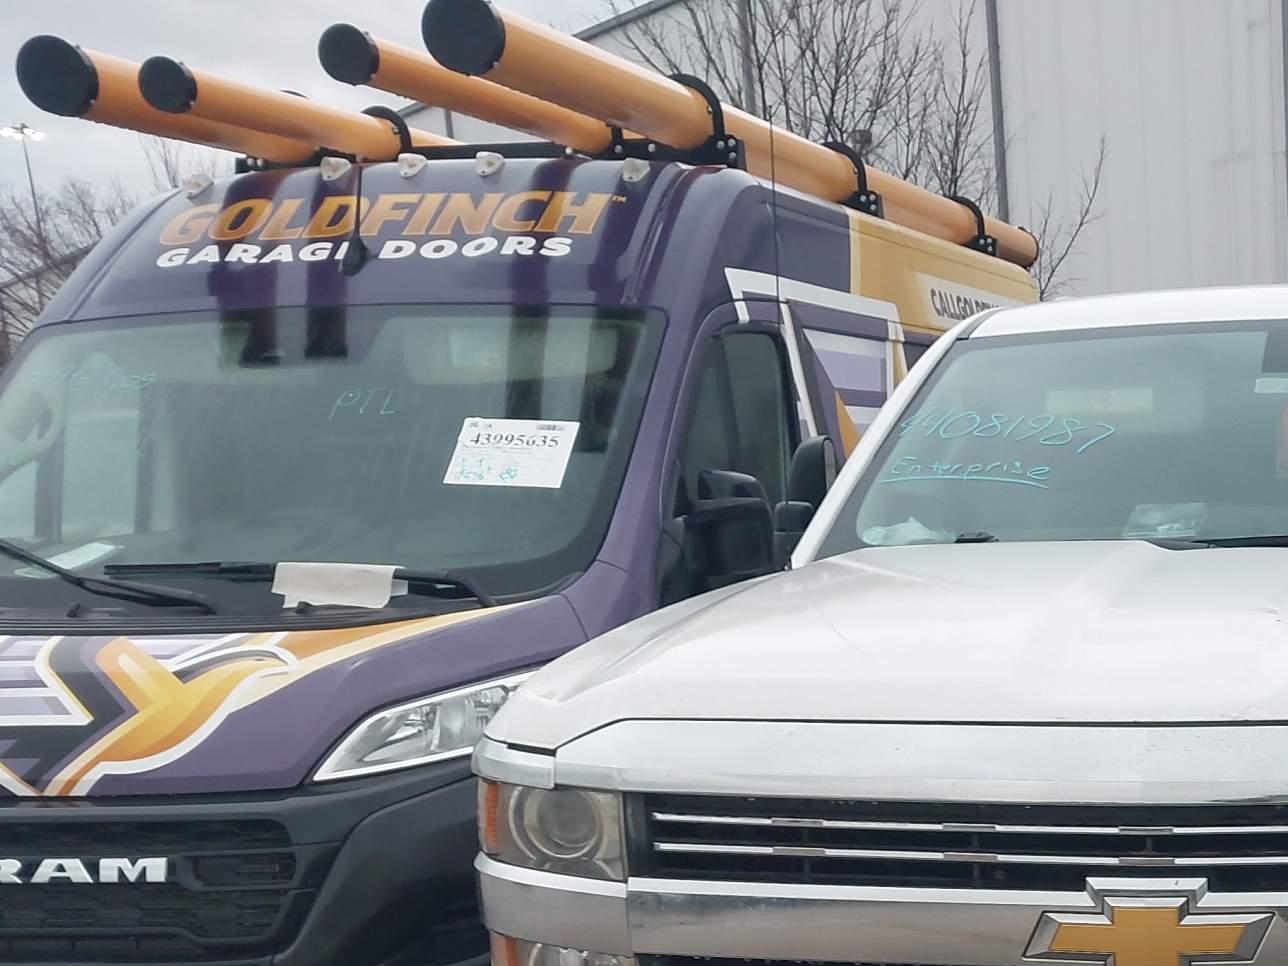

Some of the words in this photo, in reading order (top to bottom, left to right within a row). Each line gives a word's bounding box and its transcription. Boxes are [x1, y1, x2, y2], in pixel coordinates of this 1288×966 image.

[159, 190, 612, 246] GOLDFINCH
[378, 236, 573, 260] DOORS
[469, 432, 561, 448] 43995635
[900, 406, 1116, 454] 44081987
[890, 456, 1051, 481] Enterprise
